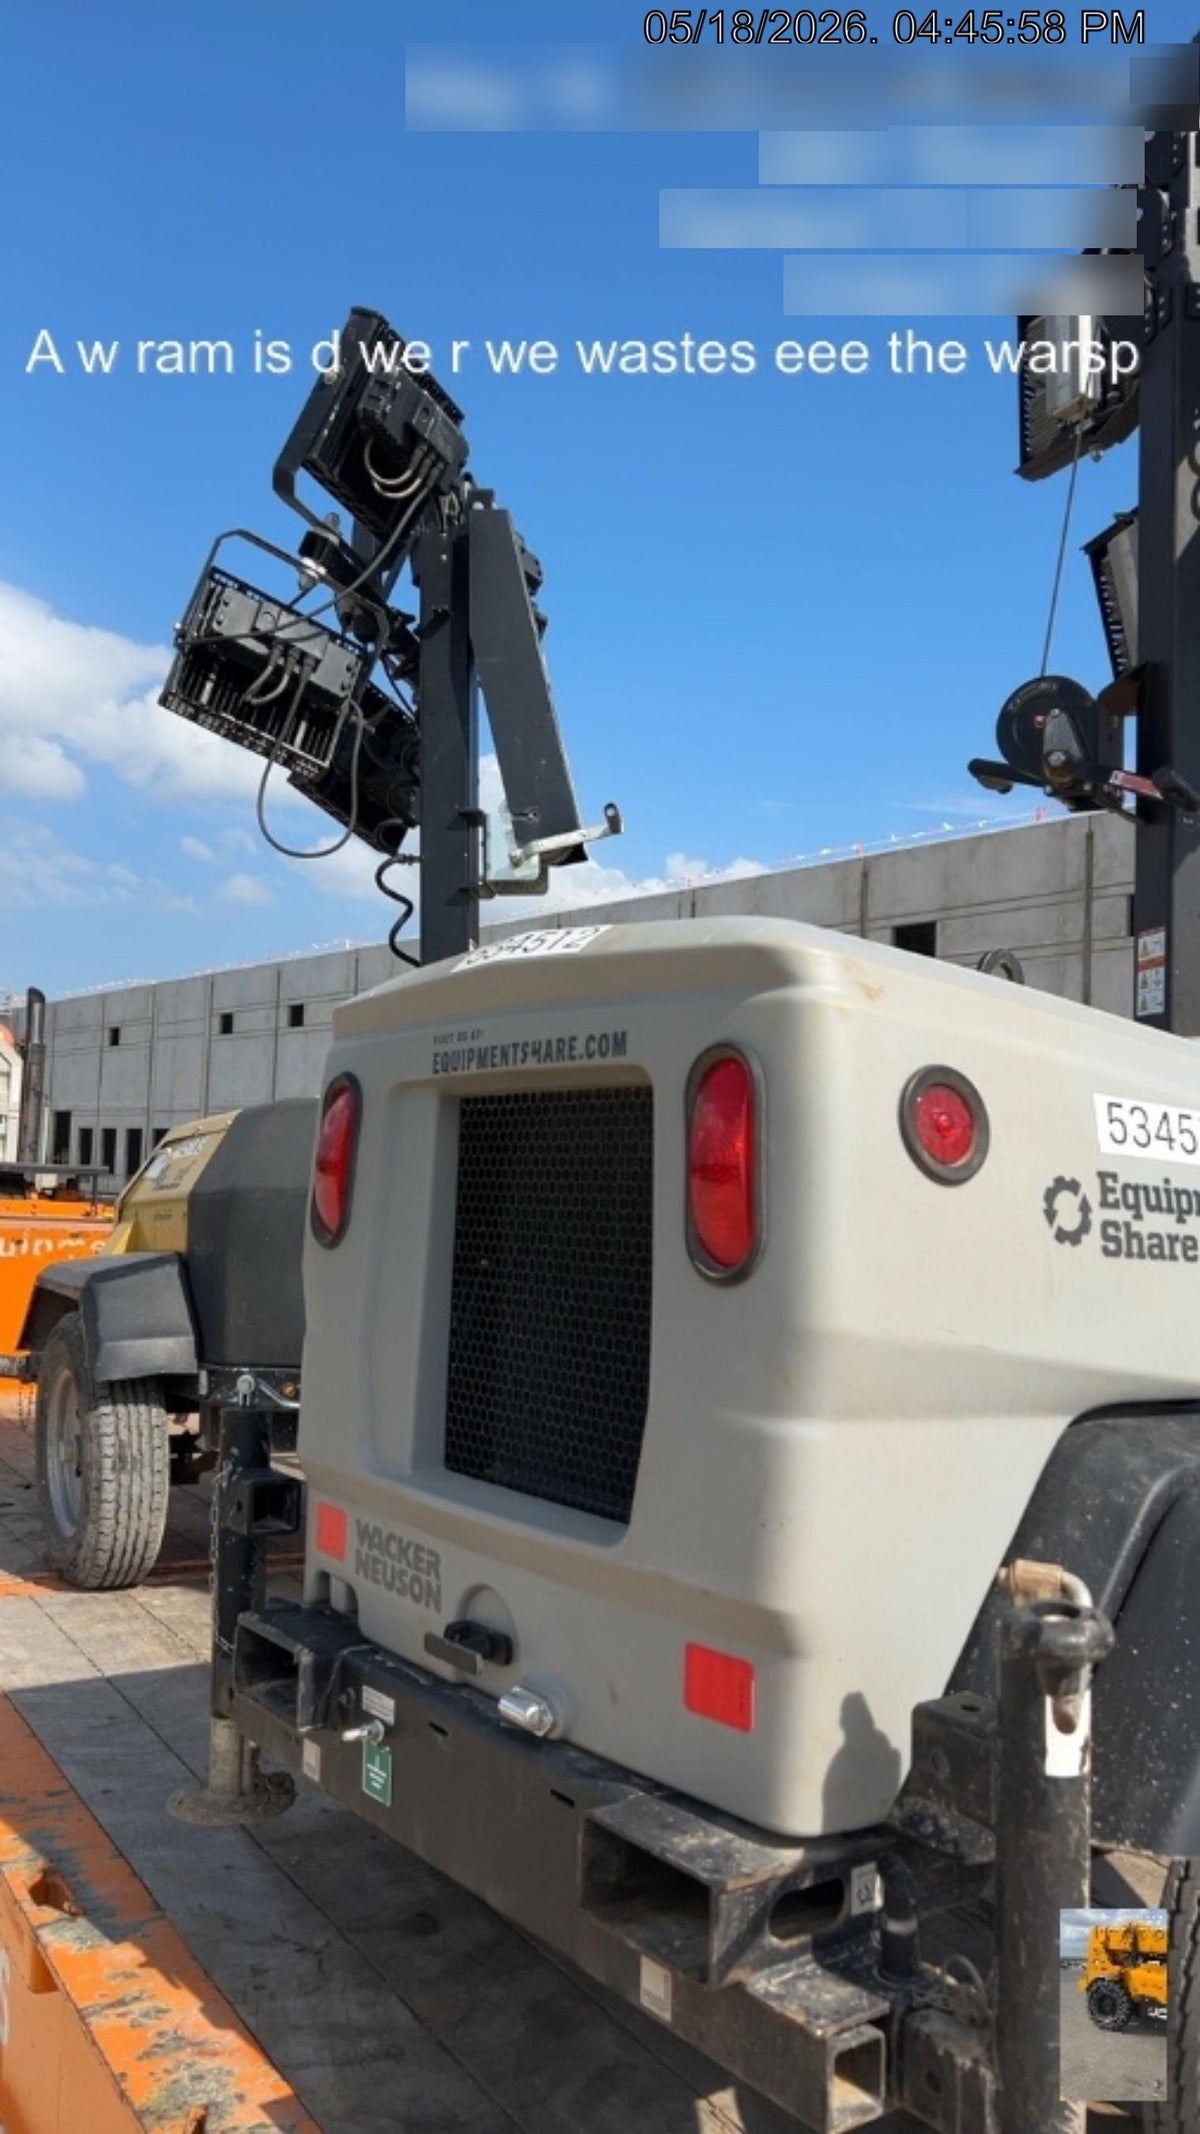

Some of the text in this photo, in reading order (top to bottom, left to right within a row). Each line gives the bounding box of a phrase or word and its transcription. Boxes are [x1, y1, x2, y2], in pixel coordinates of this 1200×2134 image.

[432, 1030, 627, 1075] EQUIPMENTSHARE.COM
[1100, 1219, 1199, 1262] Share
[356, 1518, 441, 1582] WACKER
[355, 1548, 441, 1613] NEUSON
